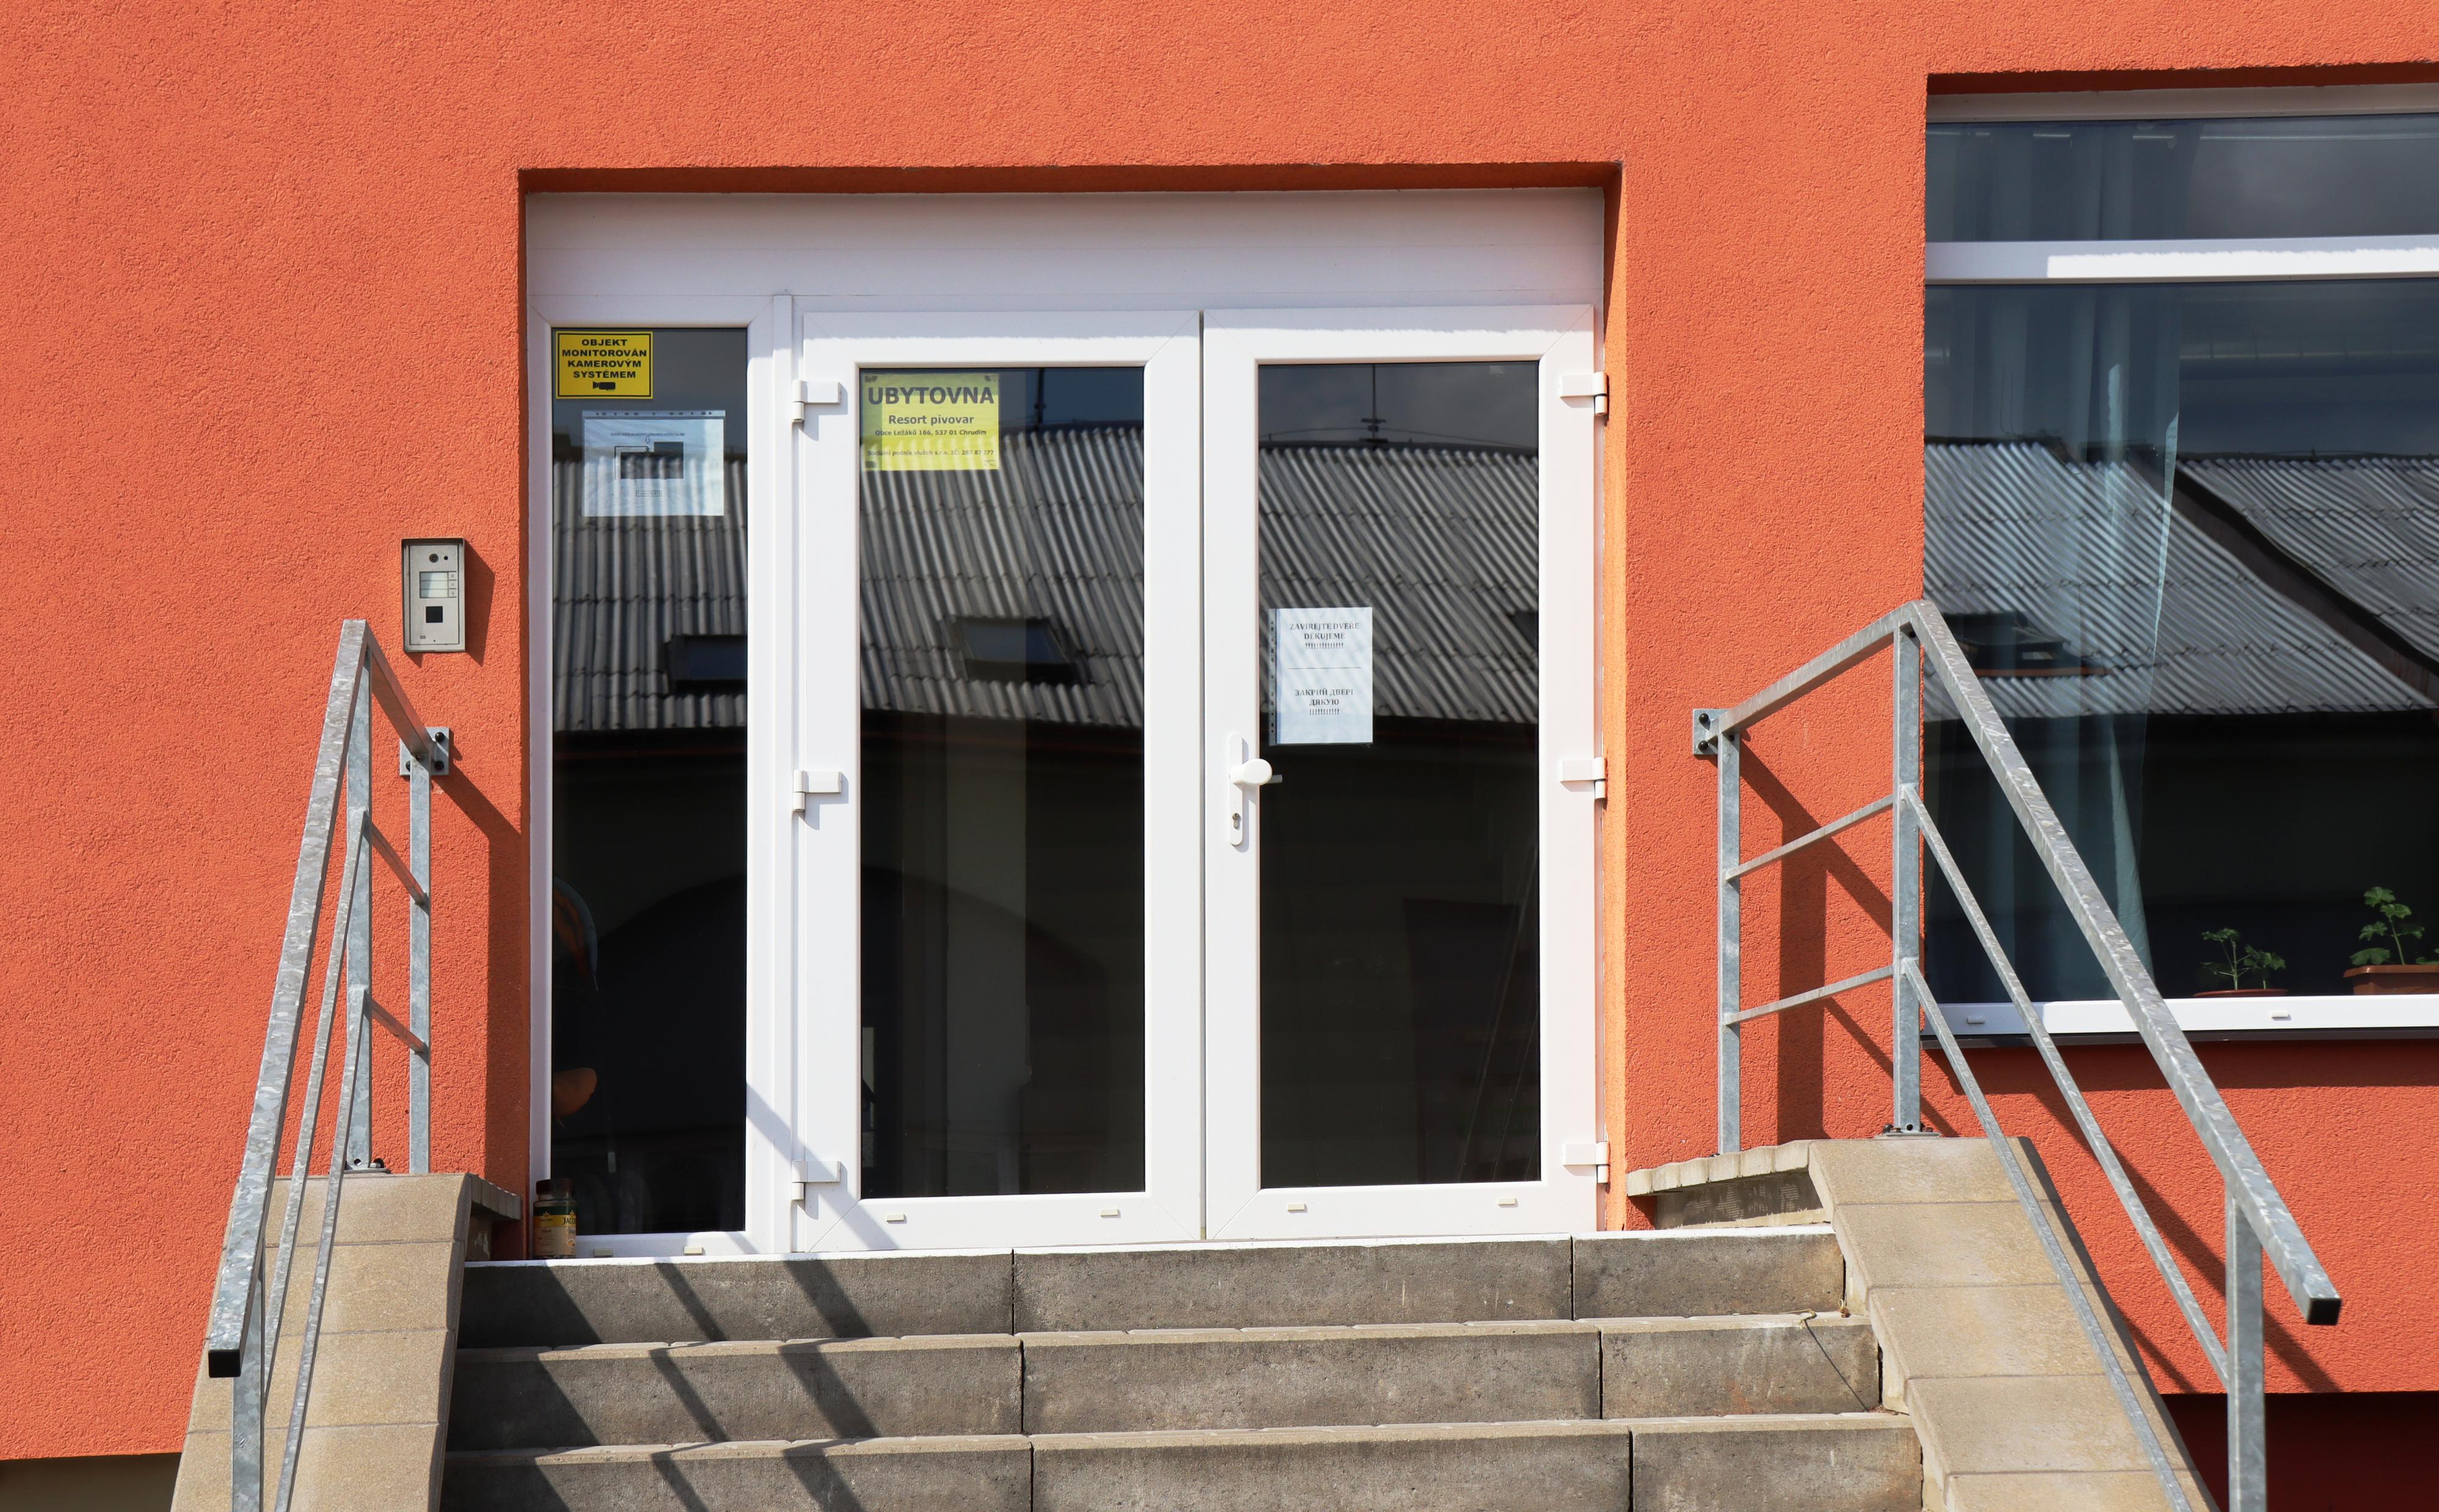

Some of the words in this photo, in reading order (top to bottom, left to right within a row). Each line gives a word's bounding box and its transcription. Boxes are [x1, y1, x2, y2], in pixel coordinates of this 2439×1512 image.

[562, 348, 647, 357] MONITOROVÁN
[568, 358, 641, 368] KAMEROVÝM
[573, 369, 636, 378] SYSTÉMEM
[868, 387, 995, 405] UBYTOVNA
[888, 415, 927, 424] Resort
[931, 415, 974, 426] pivovar
[1290, 622, 1332, 631] ZAVÍREJTE
[1295, 688, 1328, 696] ЗАКРИЙ
